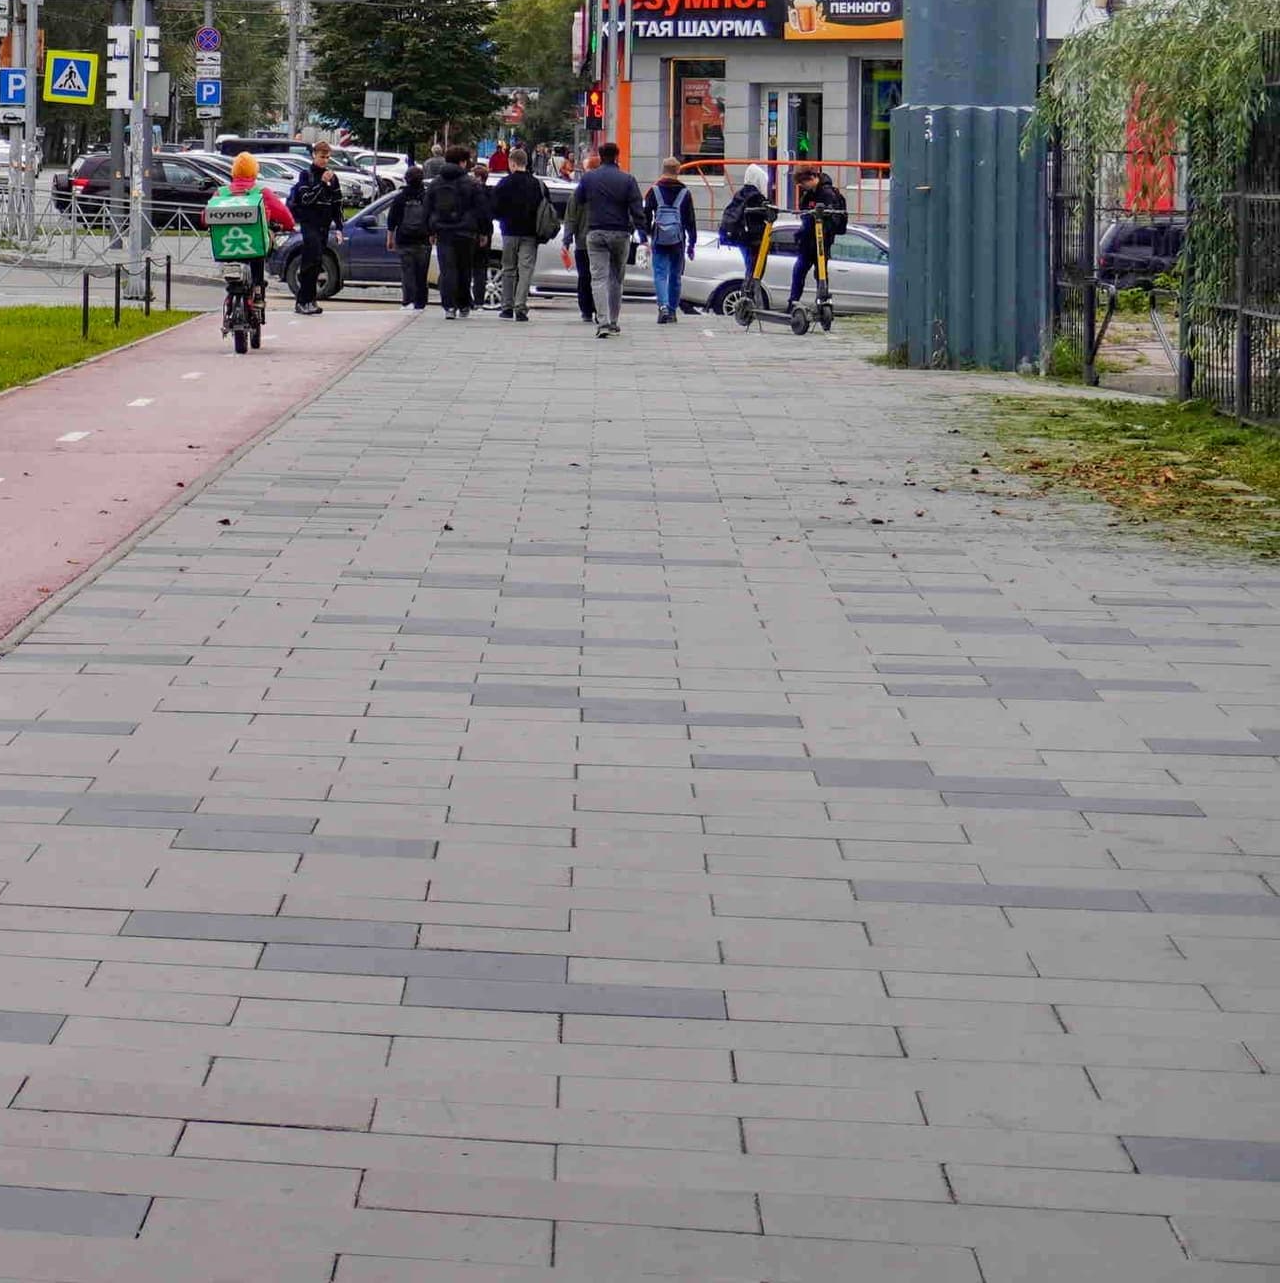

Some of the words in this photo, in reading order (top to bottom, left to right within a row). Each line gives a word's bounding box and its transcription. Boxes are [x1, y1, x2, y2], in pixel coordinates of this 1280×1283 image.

[829, 2, 891, 15] ПЕННОГО
[677, 19, 767, 37] ШАУРМА
[7, 74, 26, 99] P
[202, 83, 216, 101] P
